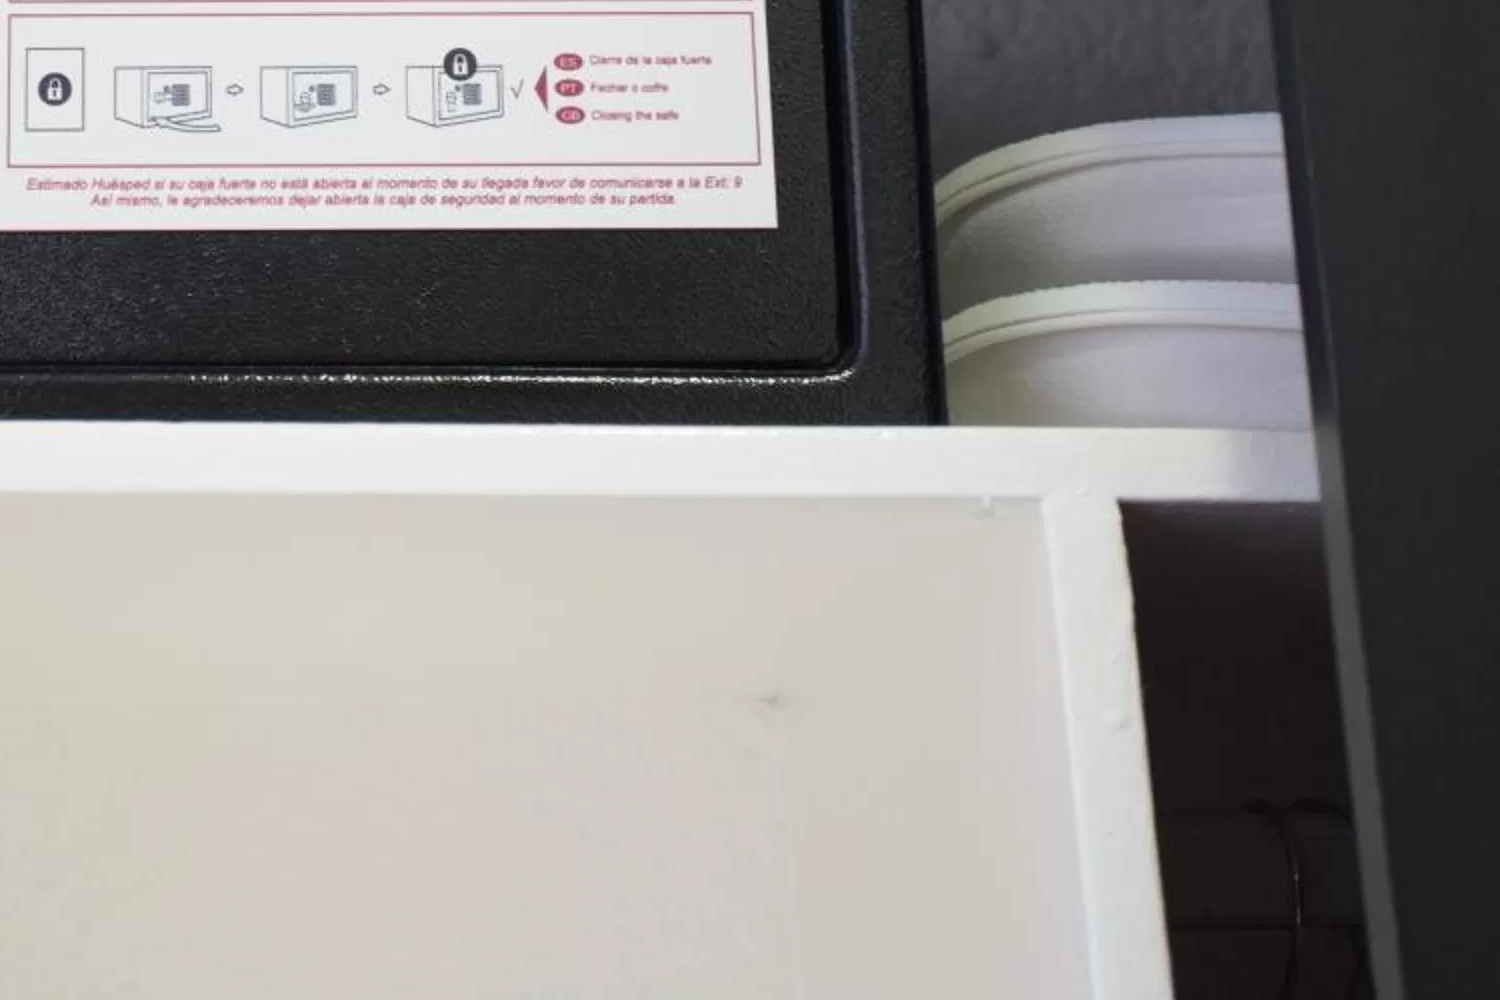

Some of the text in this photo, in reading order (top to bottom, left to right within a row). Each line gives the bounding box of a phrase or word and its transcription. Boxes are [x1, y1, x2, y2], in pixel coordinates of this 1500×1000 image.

[626, 55, 639, 66] de
[642, 55, 652, 66] la
[680, 55, 712, 66] fuerte
[636, 110, 652, 121] the
[656, 110, 679, 121] safe
[26, 178, 87, 190] Estimado
[218, 177, 256, 190] fuerte
[260, 180, 276, 190] no
[312, 178, 357, 189] abierta
[376, 178, 438, 189] momento
[441, 177, 458, 189] de
[461, 179, 477, 189] su
[531, 176, 566, 189] favor
[569, 177, 585, 188] de
[589, 178, 673, 188] comunicarse
[689, 177, 700, 188] la
[325, 193, 369, 205] abierta
[419, 193, 436, 205] de
[440, 193, 505, 208] seguridad
[524, 193, 586, 205] momento
[589, 193, 606, 205] de
[610, 195, 625, 205] su
